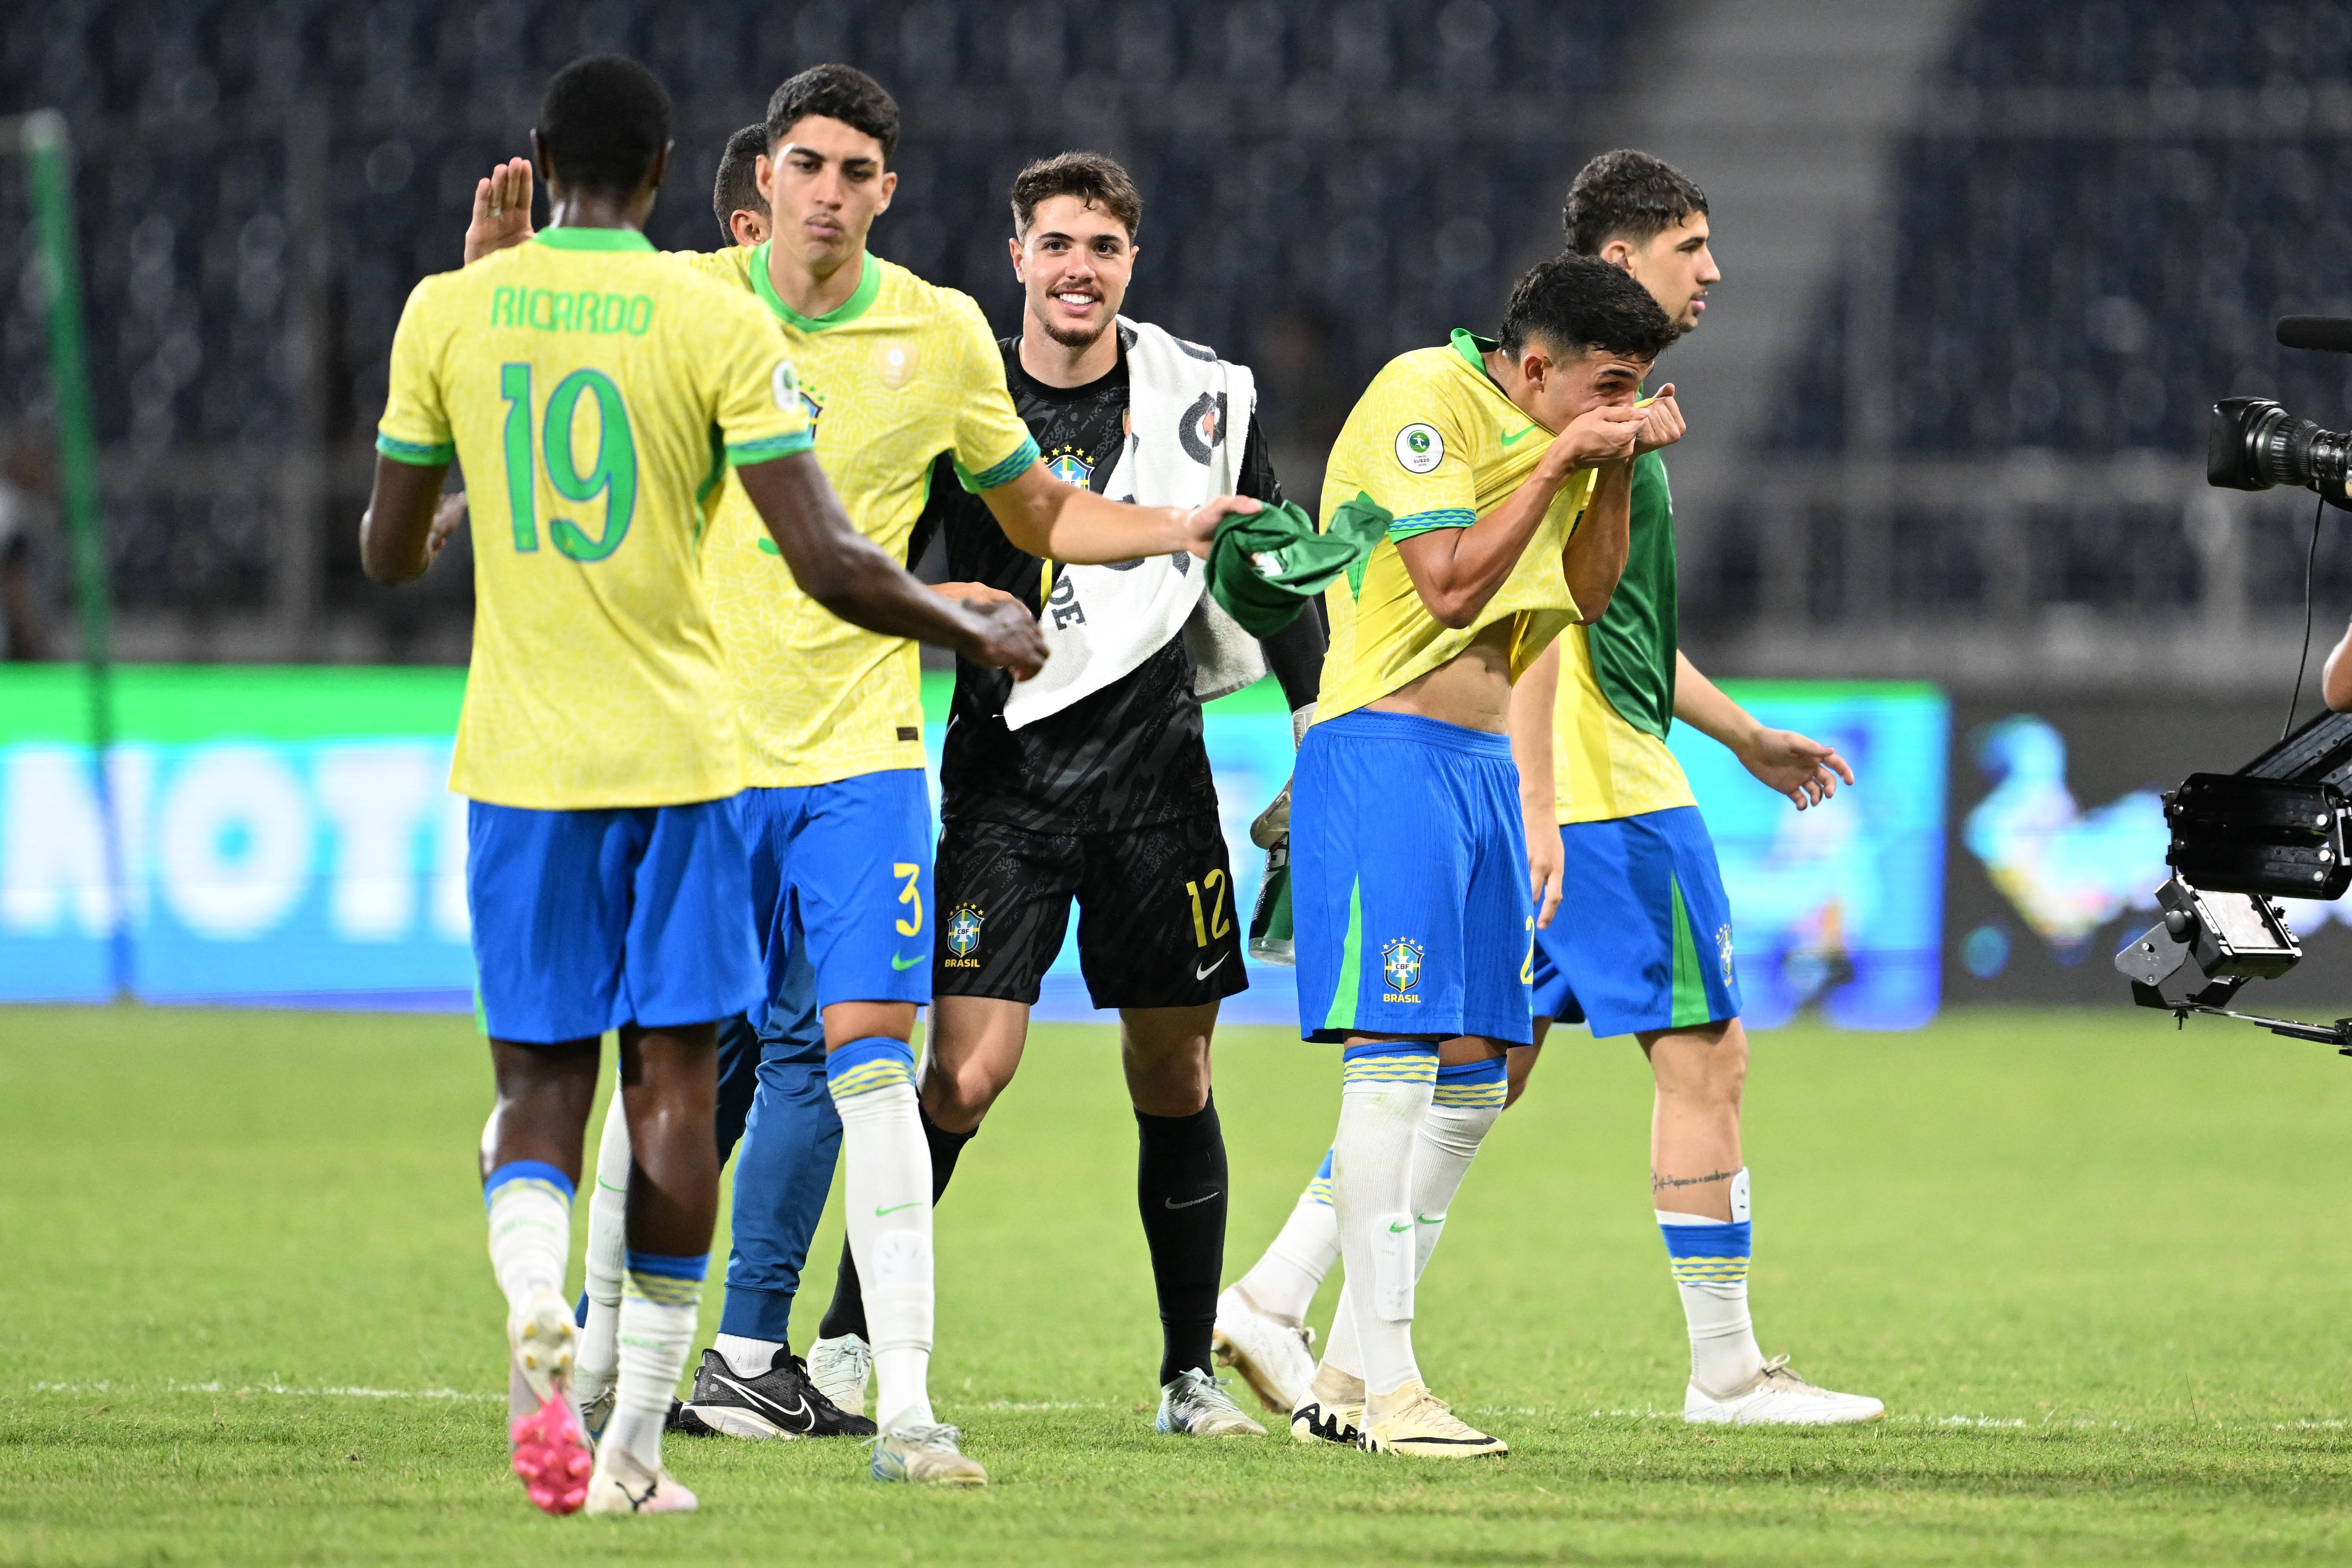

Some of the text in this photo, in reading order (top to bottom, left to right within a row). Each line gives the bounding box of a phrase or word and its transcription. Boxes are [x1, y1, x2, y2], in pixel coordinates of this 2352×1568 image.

[491, 285, 652, 336] RICARDO
[501, 362, 638, 562] 19
[893, 862, 923, 937] 3
[1186, 868, 1230, 948] 12
[945, 959, 980, 968] BRASIL
[1383, 993, 1421, 1003] BRASIL
